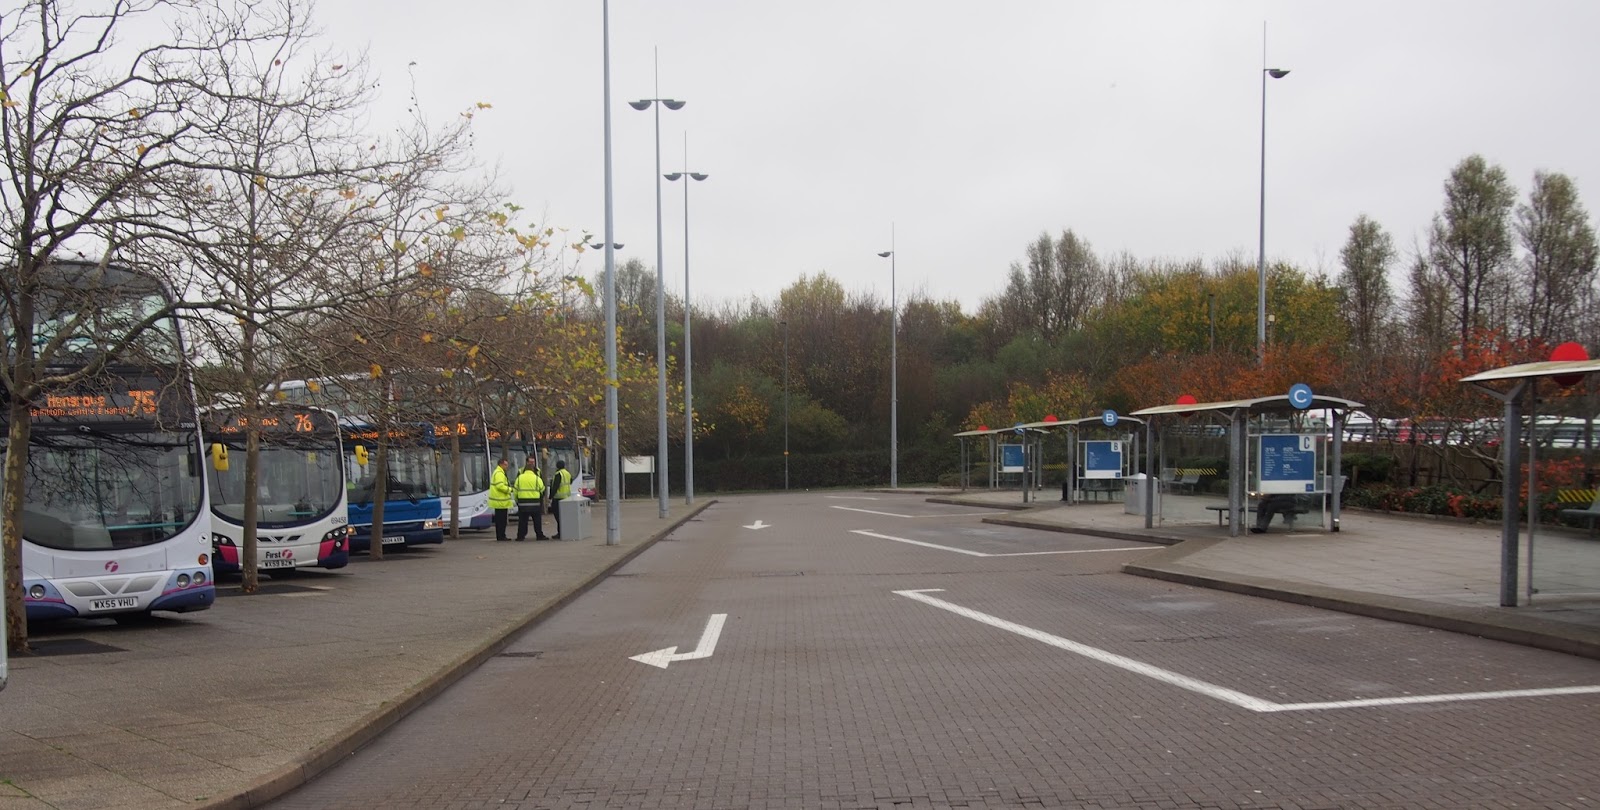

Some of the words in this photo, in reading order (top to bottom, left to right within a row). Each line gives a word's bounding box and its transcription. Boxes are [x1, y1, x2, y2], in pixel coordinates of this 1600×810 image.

[1294, 389, 1307, 403] C
[127, 390, 156, 414] 75
[294, 413, 313, 432] 76
[1105, 413, 1114, 423] B
[1113, 442, 1119, 451] B
[1303, 436, 1311, 450] C
[330, 515, 347, 525] 69458
[265, 551, 281, 559] First
[94, 599, 116, 609] WX55
[118, 598, 134, 608] VHU
